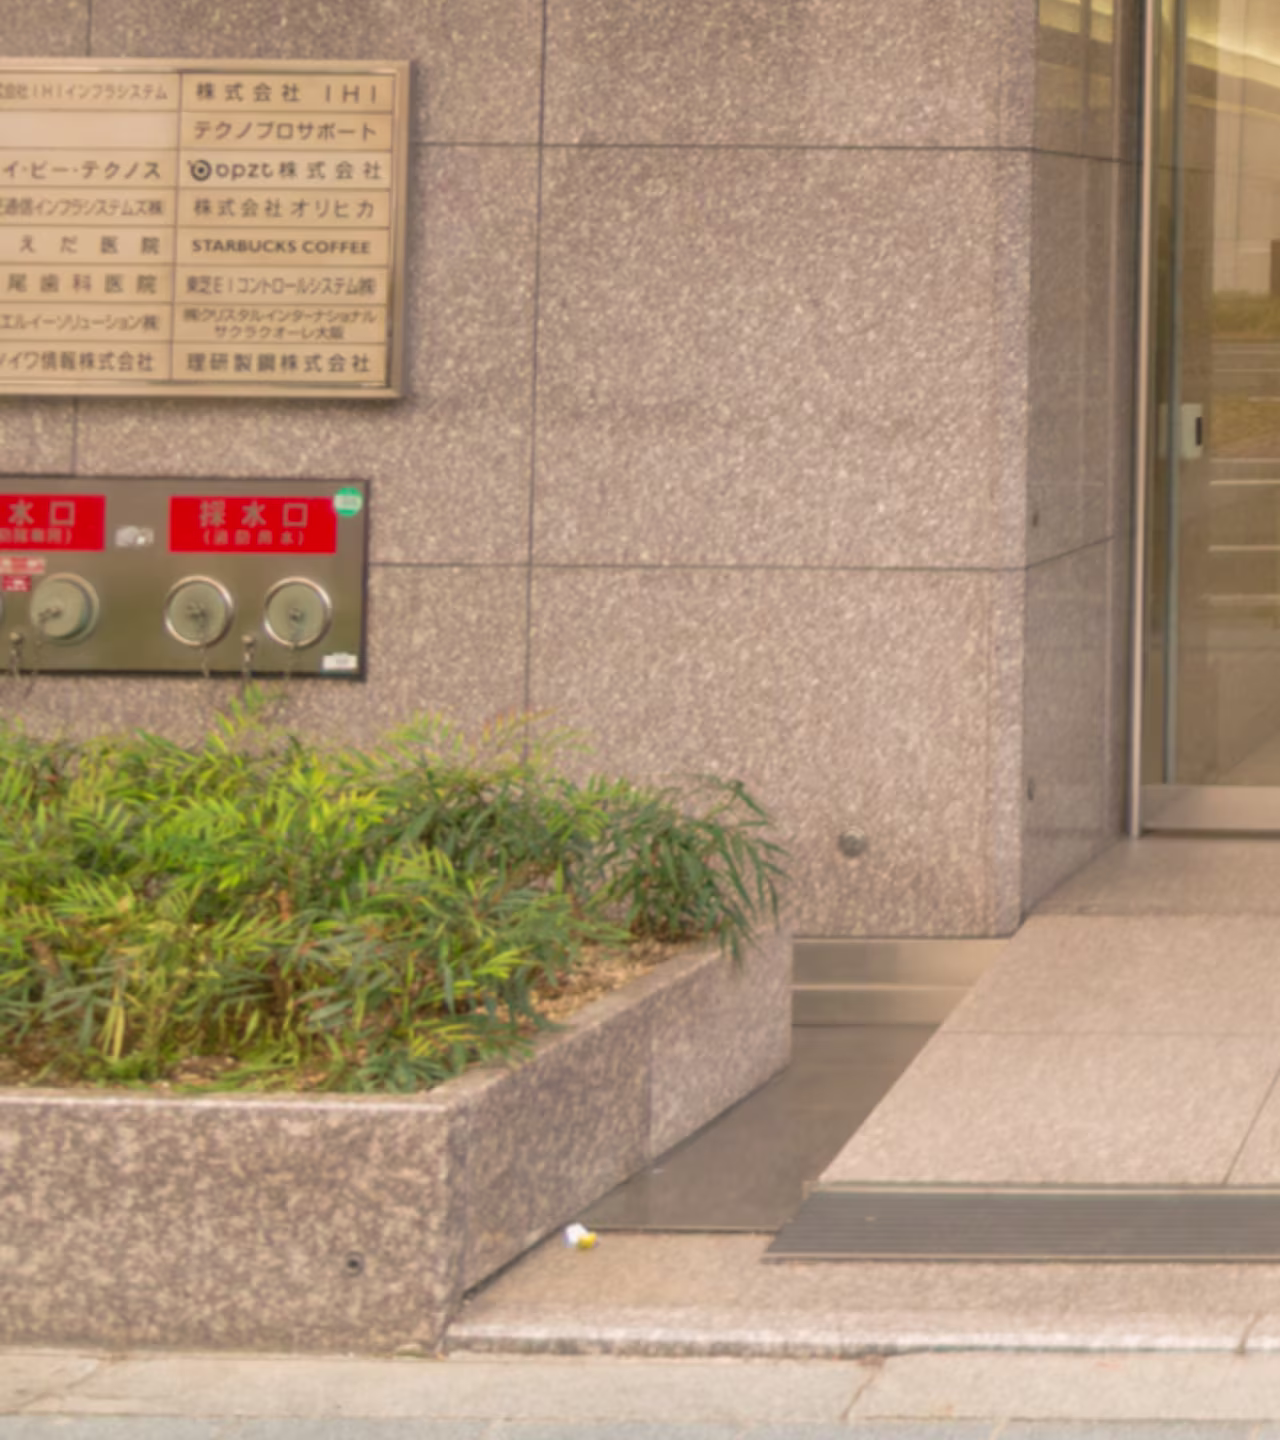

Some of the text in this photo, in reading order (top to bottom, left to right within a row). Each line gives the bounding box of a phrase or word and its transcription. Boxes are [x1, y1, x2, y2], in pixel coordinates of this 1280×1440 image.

[196, 82, 300, 102] 株式会社
[194, 121, 376, 141] テクノプロサポート
[192, 239, 371, 255] STARBUCKS COFFEE
[0, 350, 154, 372] イワ情報株式会社
